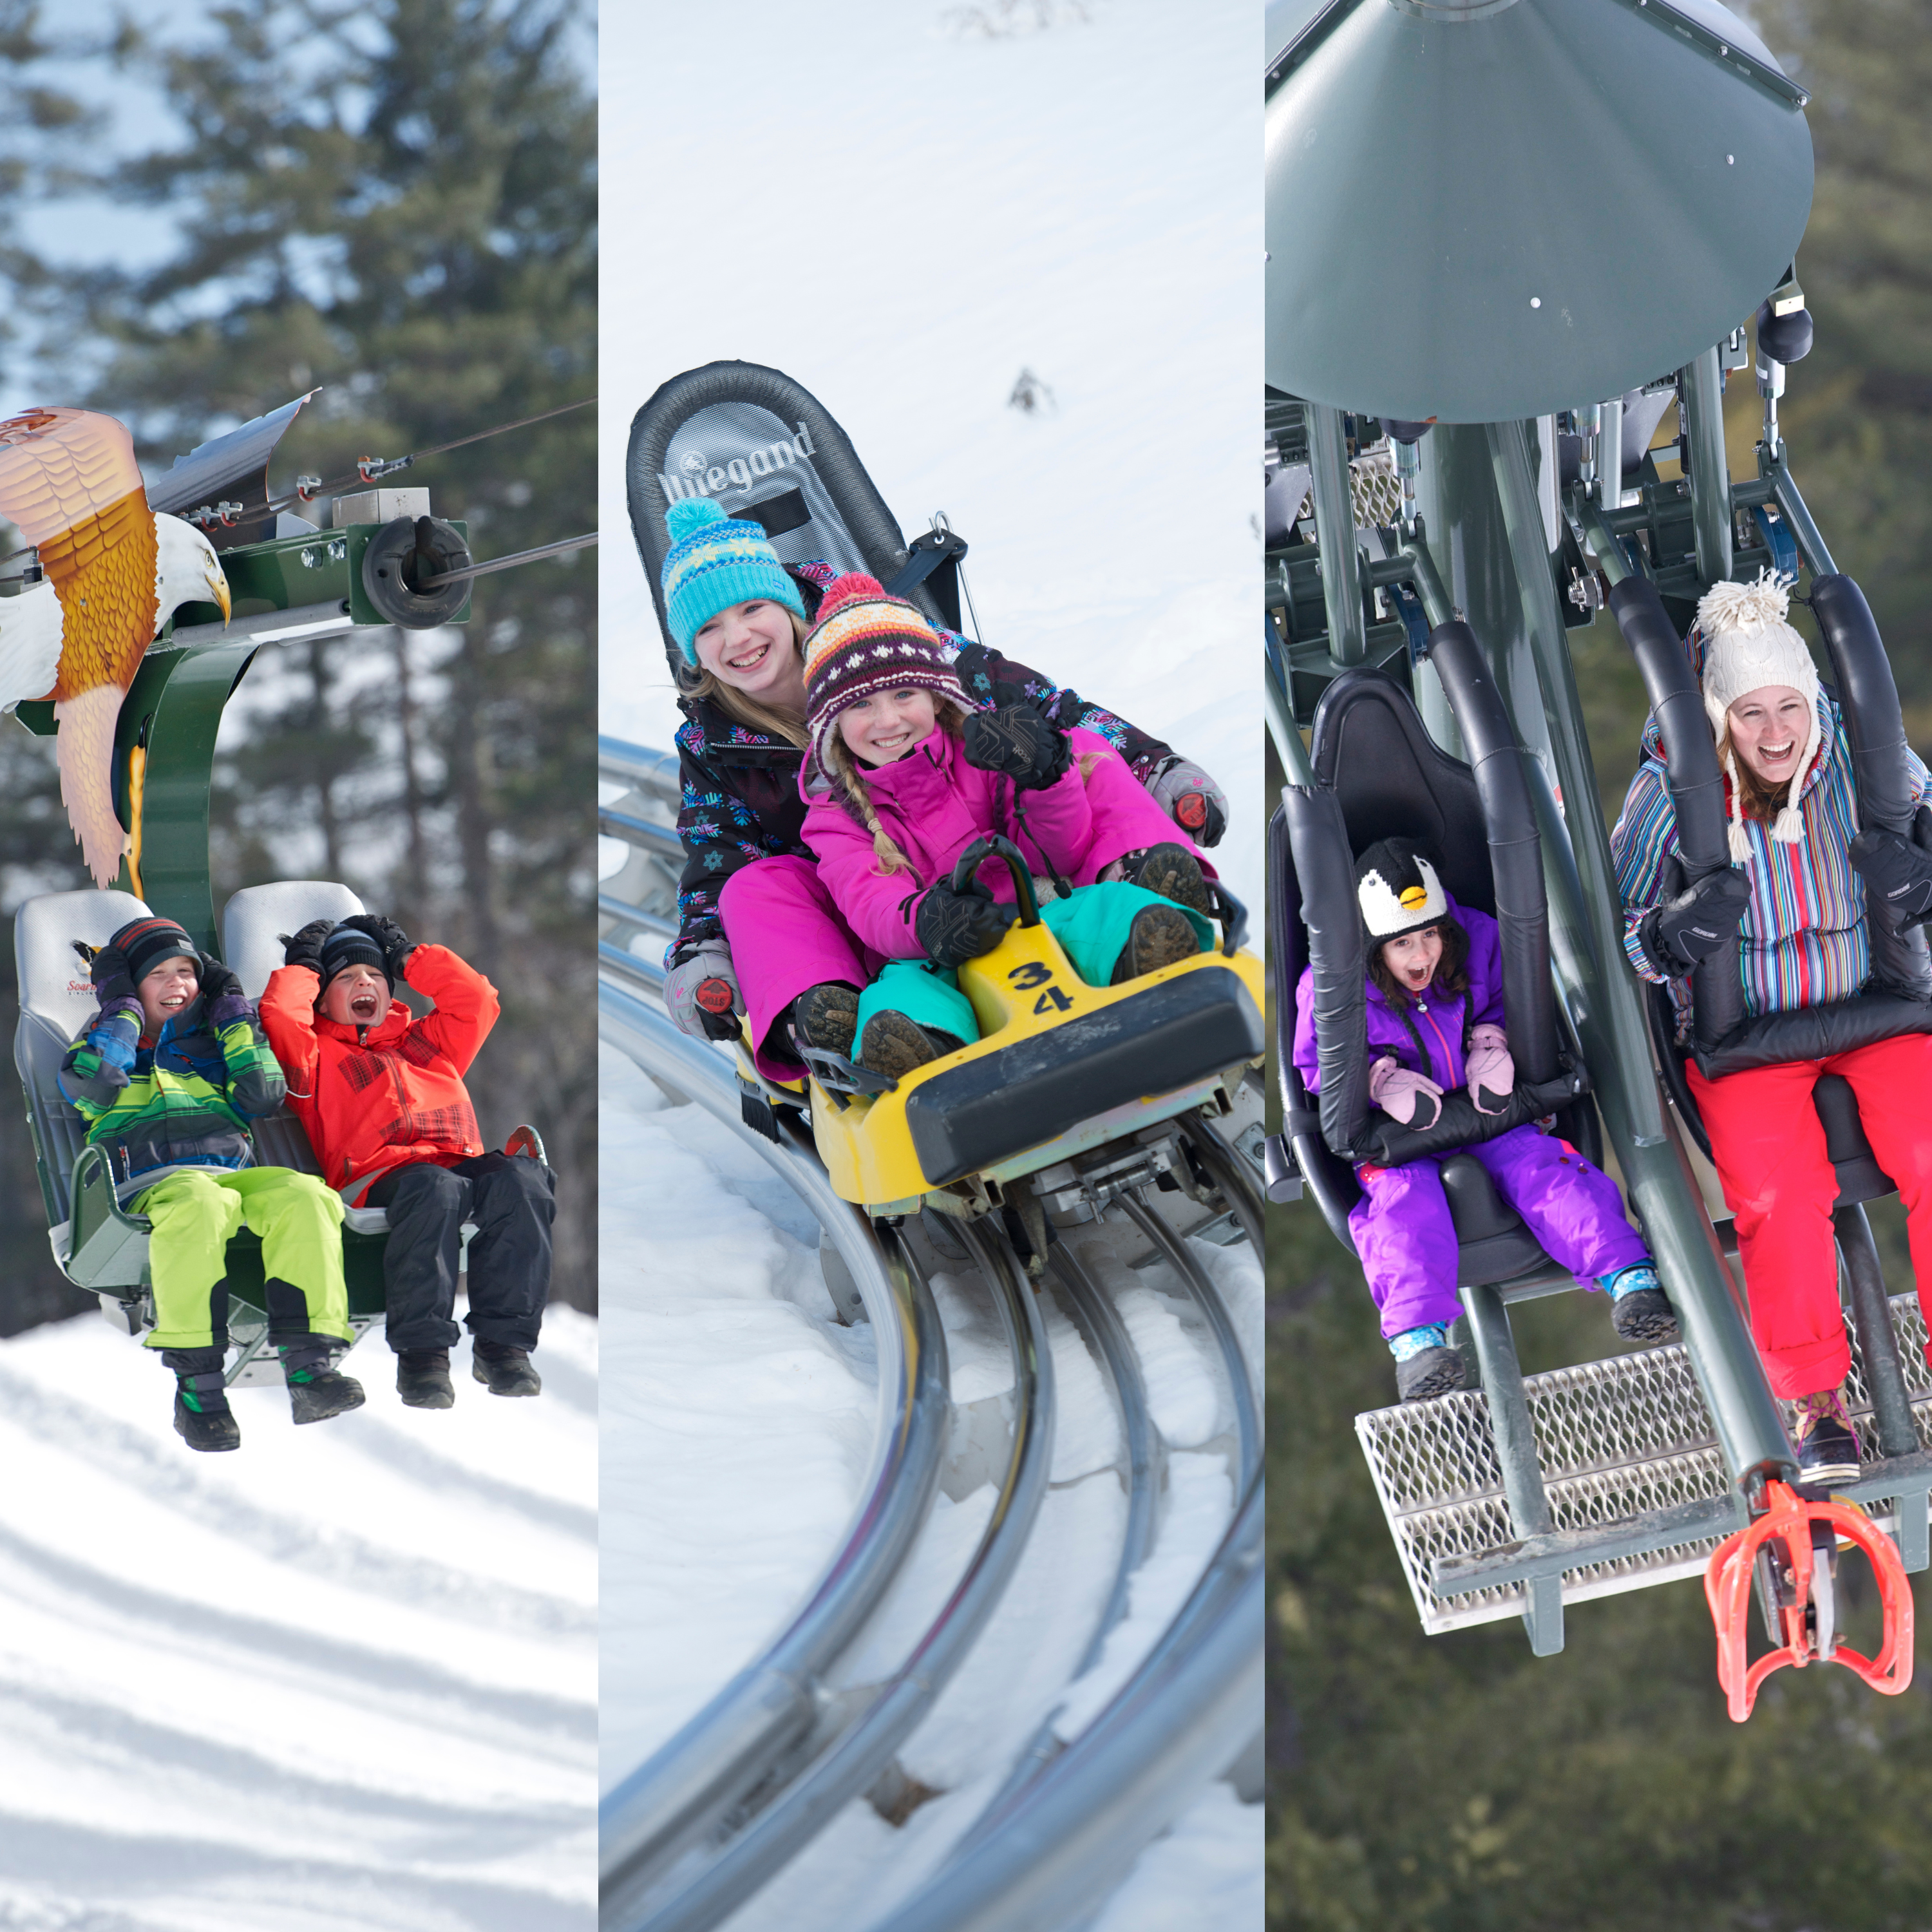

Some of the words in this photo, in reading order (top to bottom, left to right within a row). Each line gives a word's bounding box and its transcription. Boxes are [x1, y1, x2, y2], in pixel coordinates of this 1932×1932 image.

[1888, 882, 1910, 897] GORDINI
[1692, 927, 1718, 938] GORDINI
[701, 996, 725, 1007] STOP
